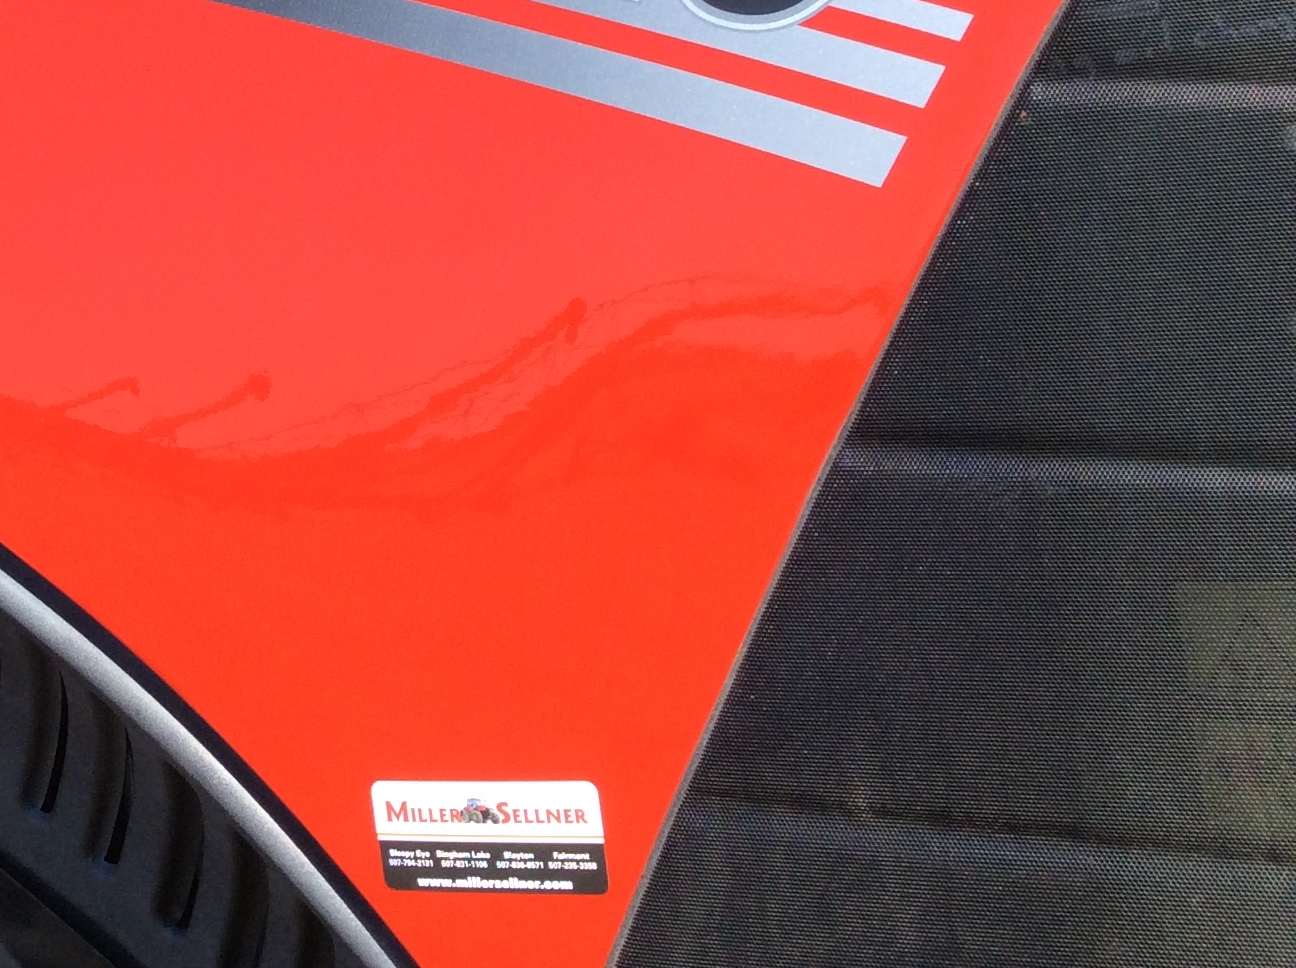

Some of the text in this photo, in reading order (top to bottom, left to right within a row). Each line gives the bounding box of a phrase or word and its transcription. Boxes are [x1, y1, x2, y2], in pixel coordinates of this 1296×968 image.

[385, 800, 589, 825] MILLER SELLNER
[471, 850, 491, 860] Lake
[552, 851, 590, 861] Fairmont
[416, 876, 574, 891] www.millersellner.com
